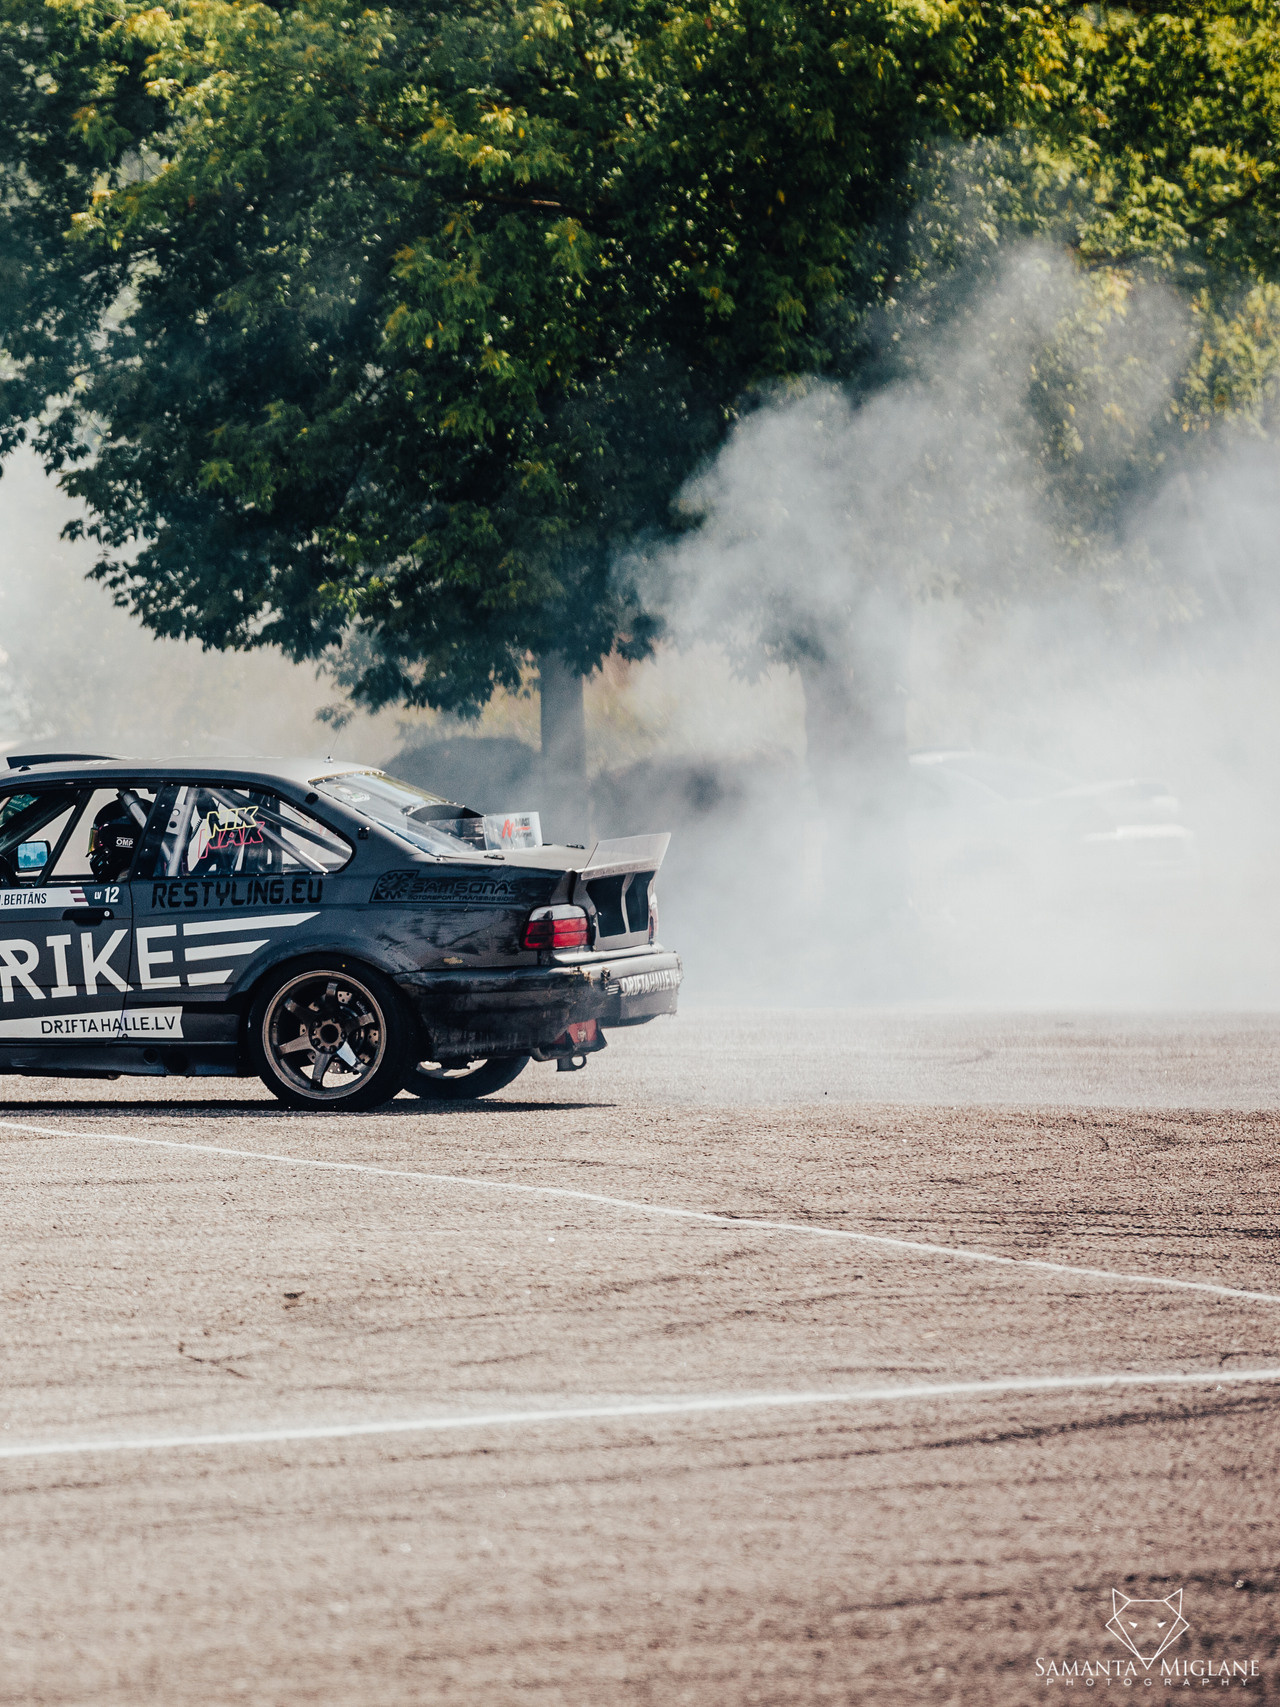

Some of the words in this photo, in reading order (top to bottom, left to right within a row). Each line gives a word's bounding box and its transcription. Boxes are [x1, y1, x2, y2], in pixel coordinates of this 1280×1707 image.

[205, 806, 258, 838] NIK
[116, 837, 133, 848] OMP
[198, 821, 265, 859] NAK
[94, 891, 102, 900] LV
[104, 886, 120, 903] 12
[151, 879, 323, 909] RESTYLING.EU
[411, 881, 519, 895] SAMSONAS
